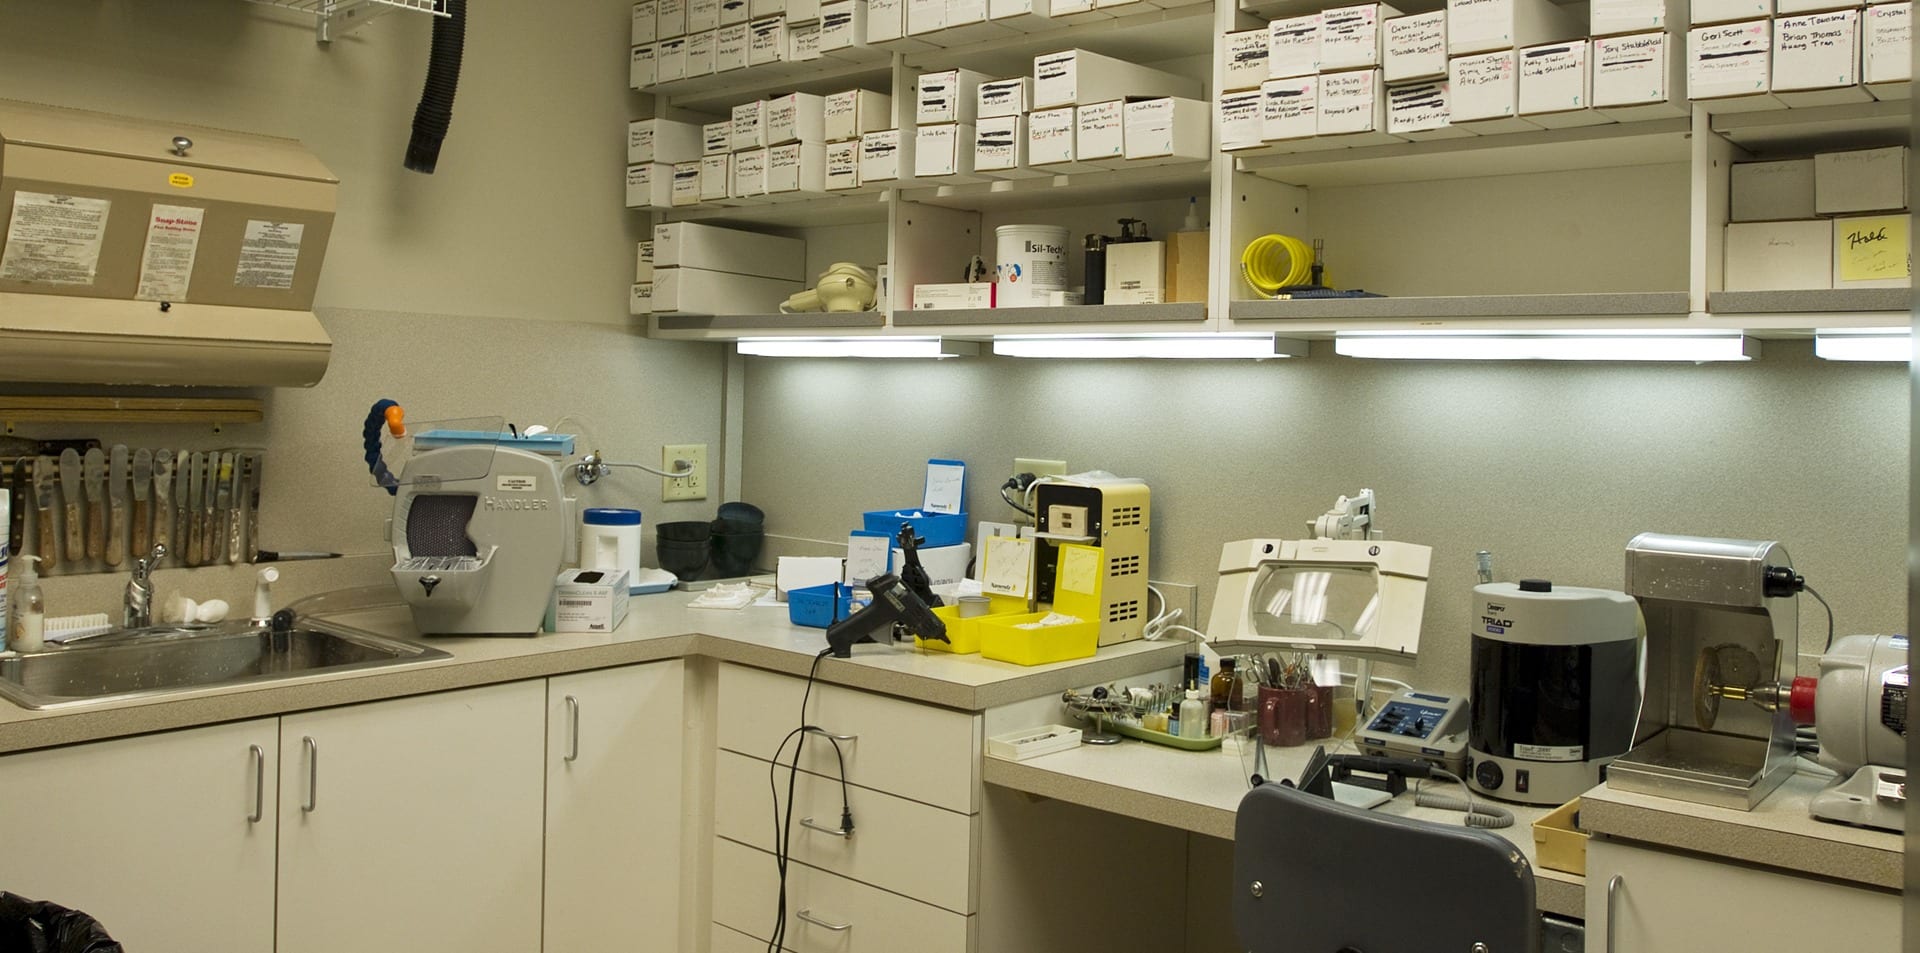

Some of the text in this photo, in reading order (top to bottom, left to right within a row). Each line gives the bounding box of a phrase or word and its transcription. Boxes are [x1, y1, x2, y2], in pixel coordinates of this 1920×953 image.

[1784, 14, 1846, 29] Anne Townsend
[1722, 29, 1744, 37] Scott
[1782, 30, 1842, 42] Brian Thomas
[1031, 244, 1064, 254] Sil-Tech
[484, 495, 550, 512] HANDLER
[1481, 616, 1513, 628] TRIAD
